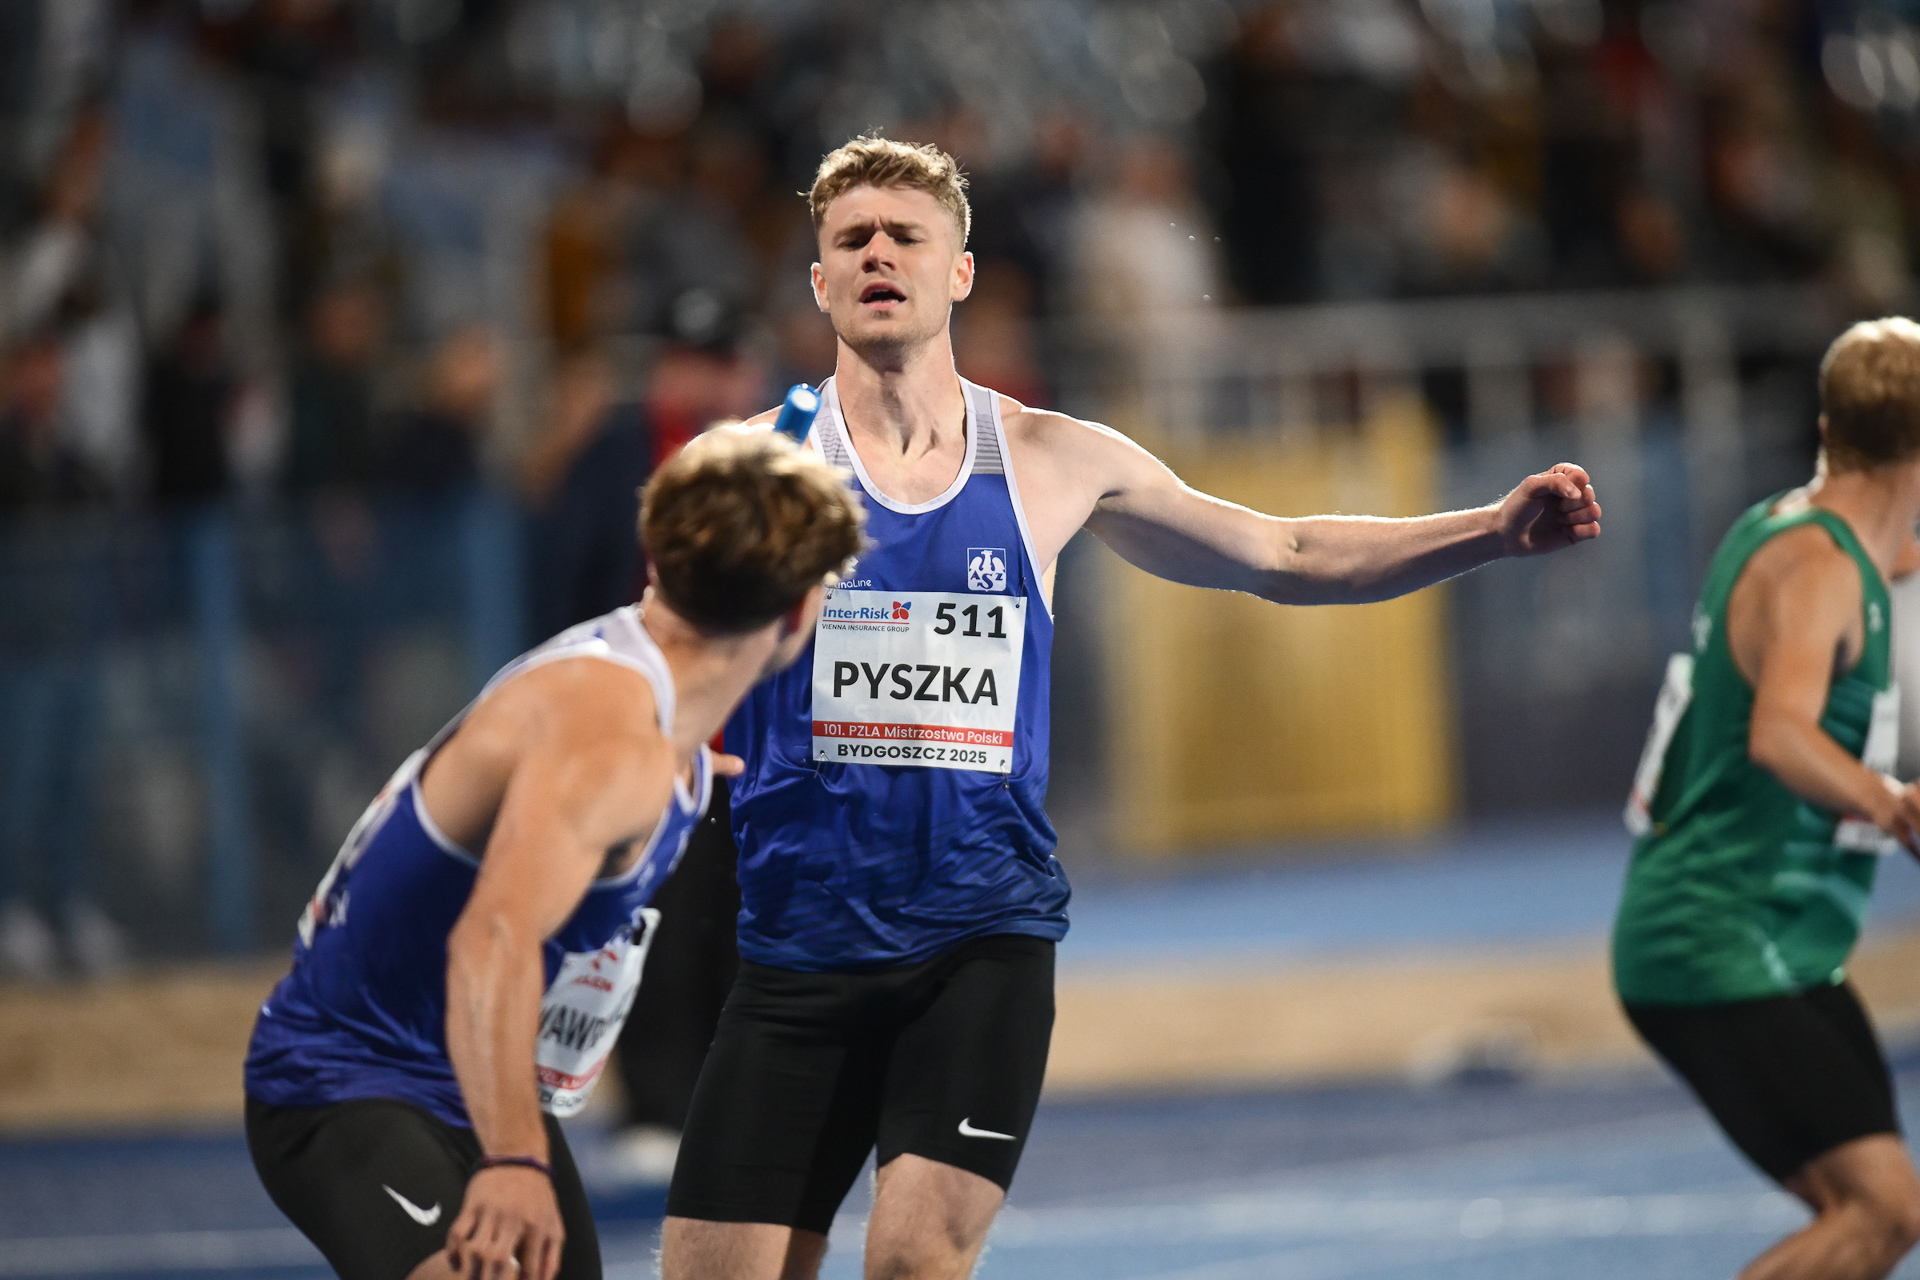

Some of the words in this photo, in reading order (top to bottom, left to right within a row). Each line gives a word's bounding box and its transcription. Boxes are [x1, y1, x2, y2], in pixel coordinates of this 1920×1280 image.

[823, 605, 890, 620] InterRisk
[933, 602, 1007, 639] 511
[847, 624, 885, 632] INSURANCE
[833, 661, 999, 706] PYSZKA
[823, 723, 846, 736] 101.
[849, 725, 880, 737] PZLA
[884, 725, 965, 742] Mistrzostwa
[967, 730, 1003, 745] Polski
[837, 743, 946, 761] BYDGOSZCZ
[949, 748, 987, 764] 2025
